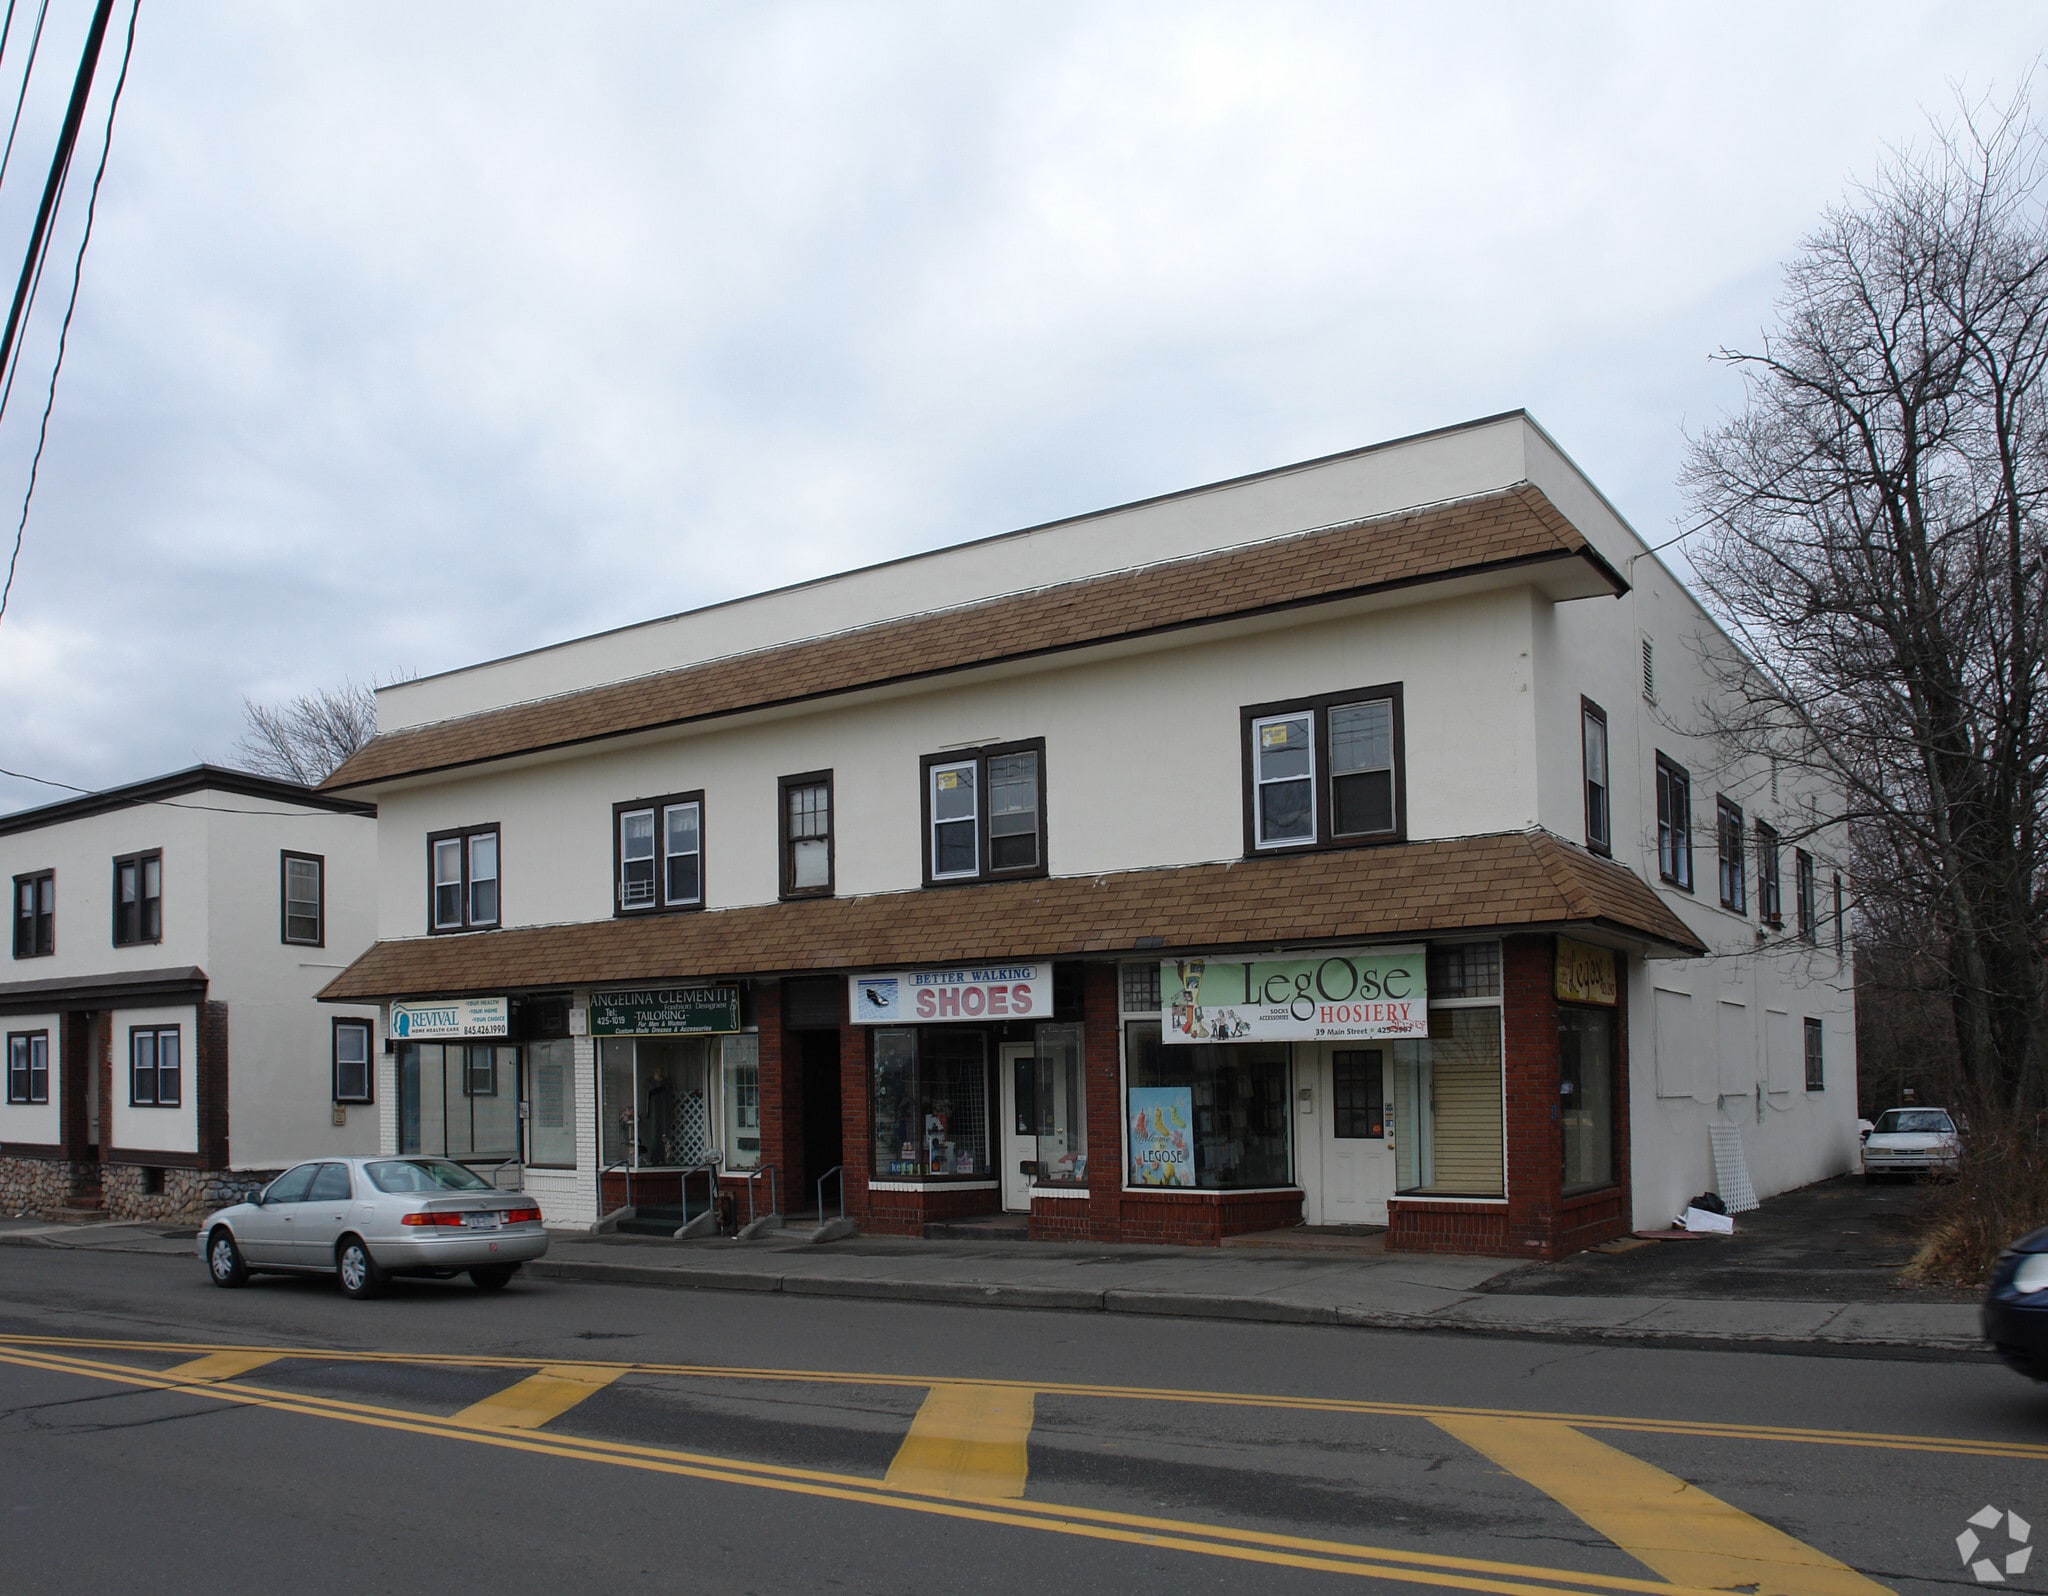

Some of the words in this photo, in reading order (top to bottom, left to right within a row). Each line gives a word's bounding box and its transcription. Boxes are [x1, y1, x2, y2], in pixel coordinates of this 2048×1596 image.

[915, 971, 965, 985] BETTER
[971, 967, 1031, 981] WALKING
[1241, 956, 1412, 1022] LegOse
[590, 992, 654, 1007] ANGELINA
[658, 988, 727, 1004] CLEMENTI
[915, 983, 1033, 1019] SHOES
[605, 1008, 618, 1016] Tel:
[695, 1002, 727, 1010] Designer
[1319, 1002, 1413, 1024] HOSIERY
[411, 1011, 460, 1027] REVIVAL
[463, 1024, 506, 1035] 845.426.1990
[1315, 1028, 1325, 1036] 39
[1326, 1028, 1346, 1036] Main
[1346, 1027, 1368, 1035] Street
[1142, 1150, 1183, 1163] LEGOSE
